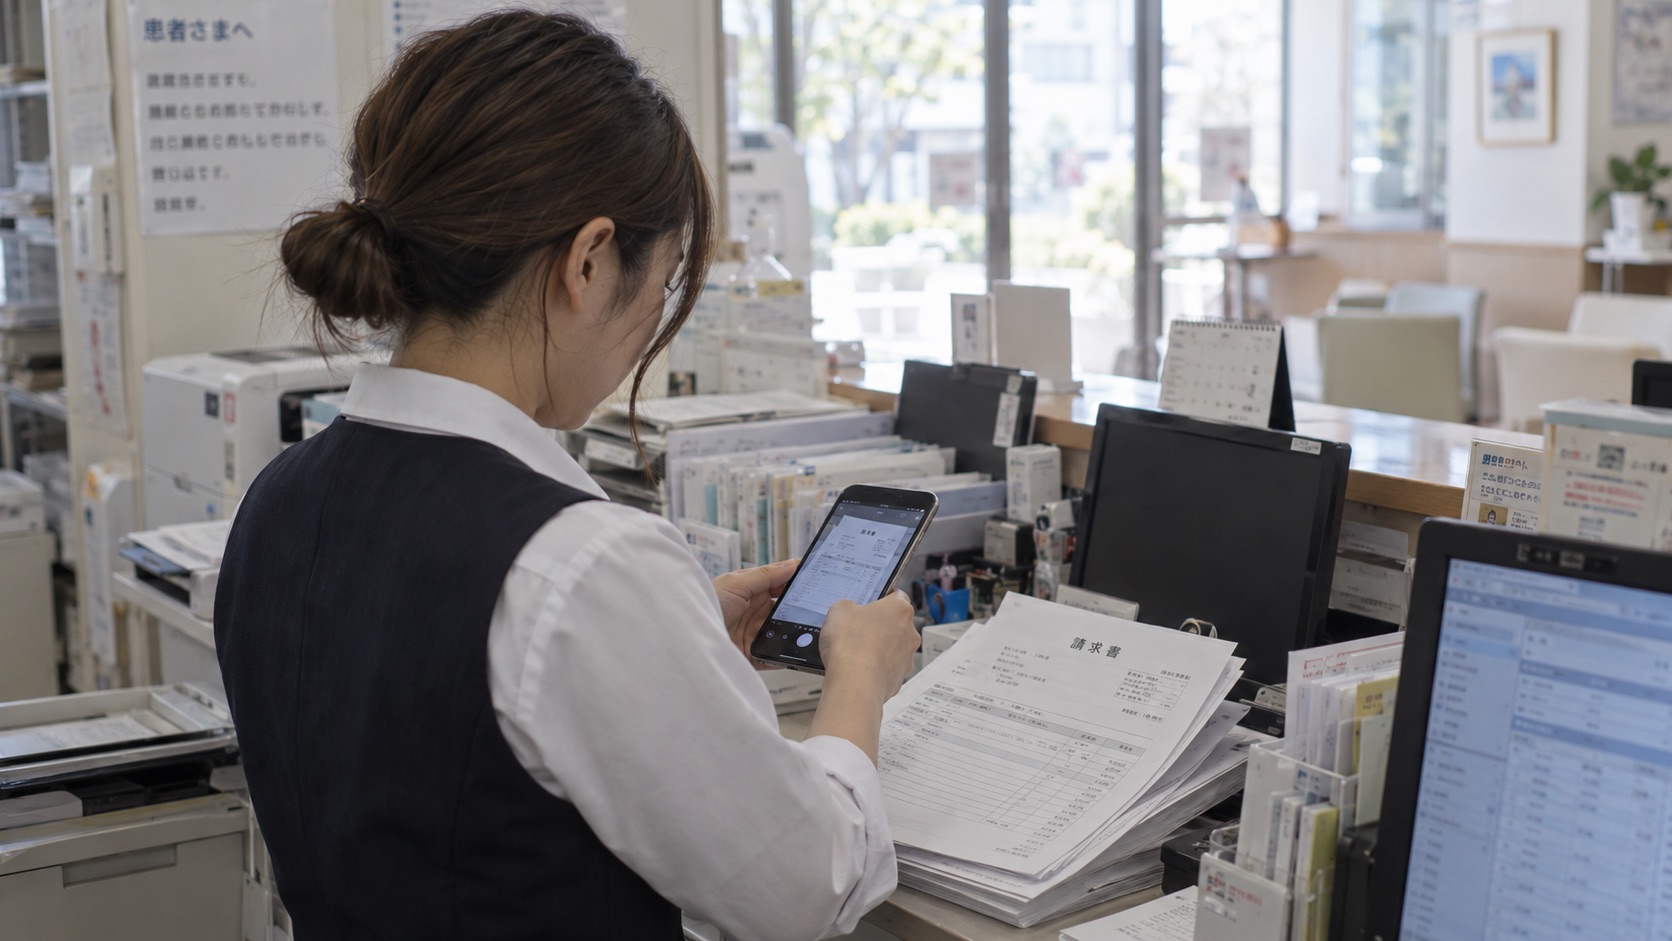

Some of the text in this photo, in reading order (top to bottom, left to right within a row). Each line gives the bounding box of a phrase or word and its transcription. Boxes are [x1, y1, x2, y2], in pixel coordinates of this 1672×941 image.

[143, 18, 254, 42] 患者さまへ
[1070, 637, 1121, 659] 請求書
